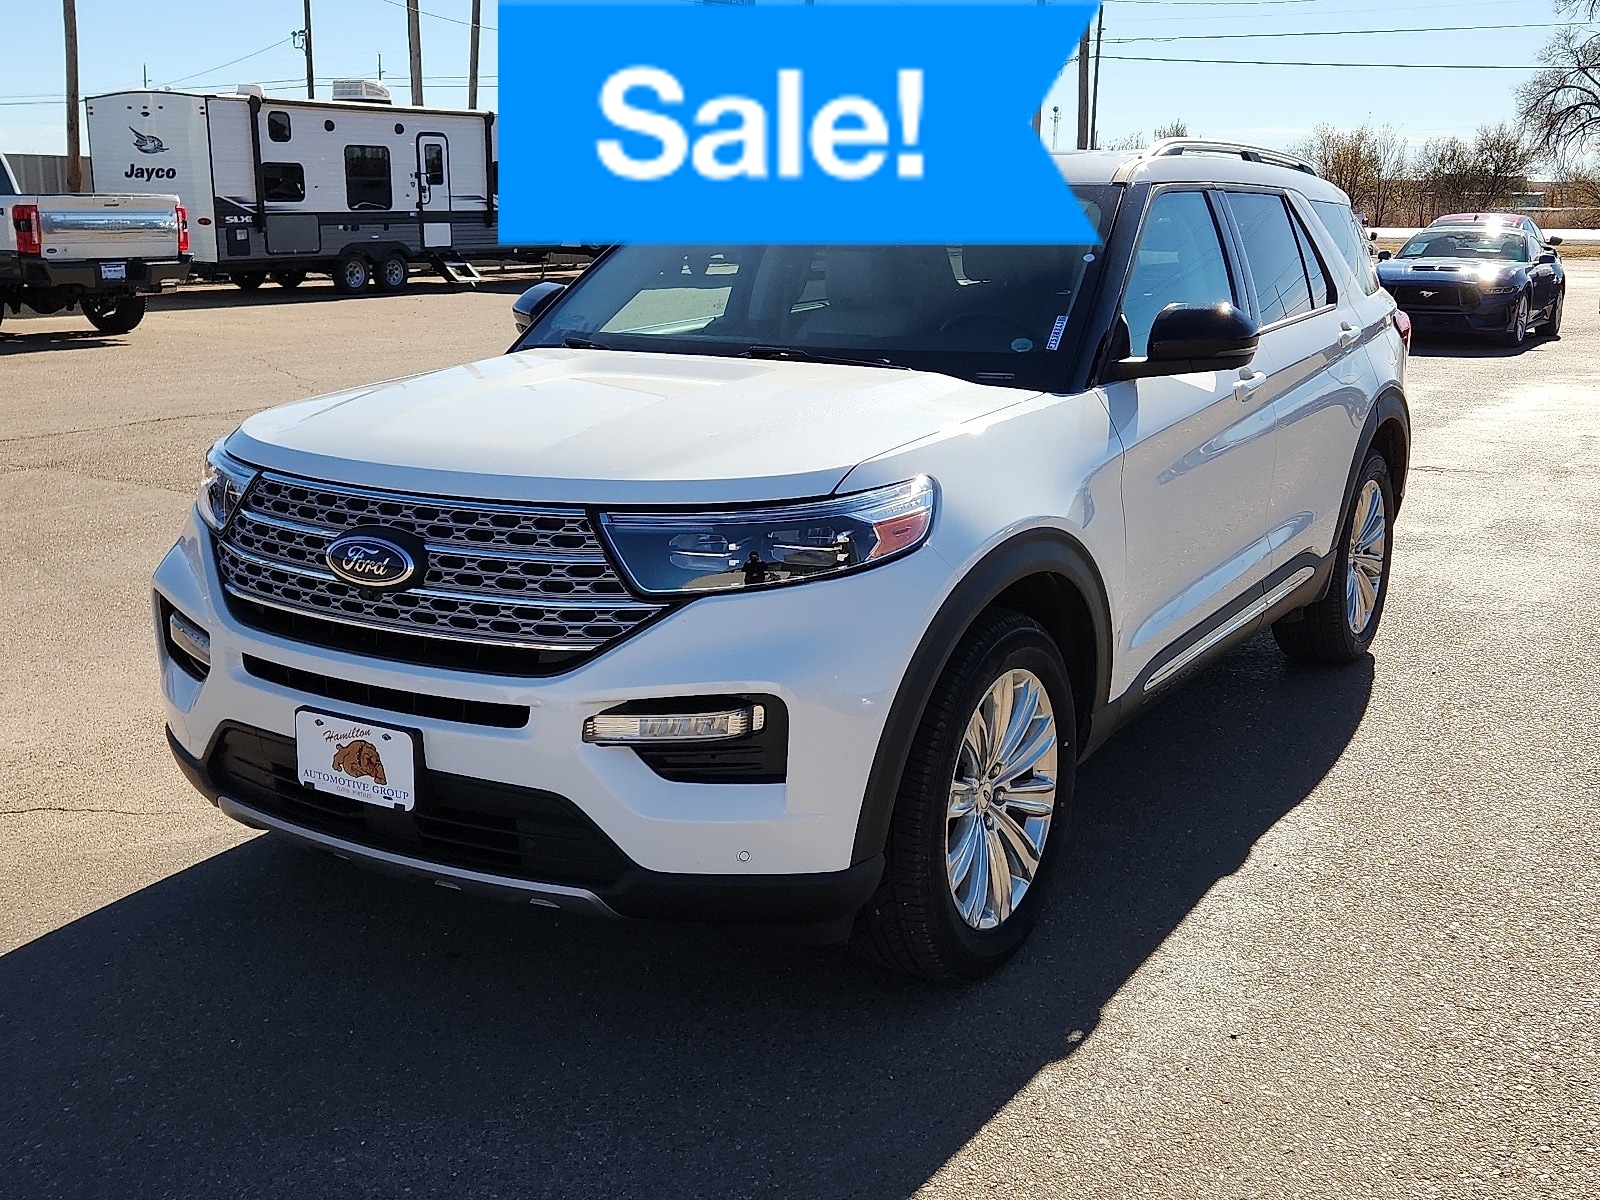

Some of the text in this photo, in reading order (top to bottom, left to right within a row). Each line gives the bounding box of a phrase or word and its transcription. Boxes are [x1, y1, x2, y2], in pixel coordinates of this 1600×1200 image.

[124, 163, 177, 182] Jayco
[342, 546, 390, 575] Ford
[322, 727, 372, 742] Hamilton
[303, 768, 370, 792] AUTOMOTIVE
[372, 784, 409, 800] GROUP
